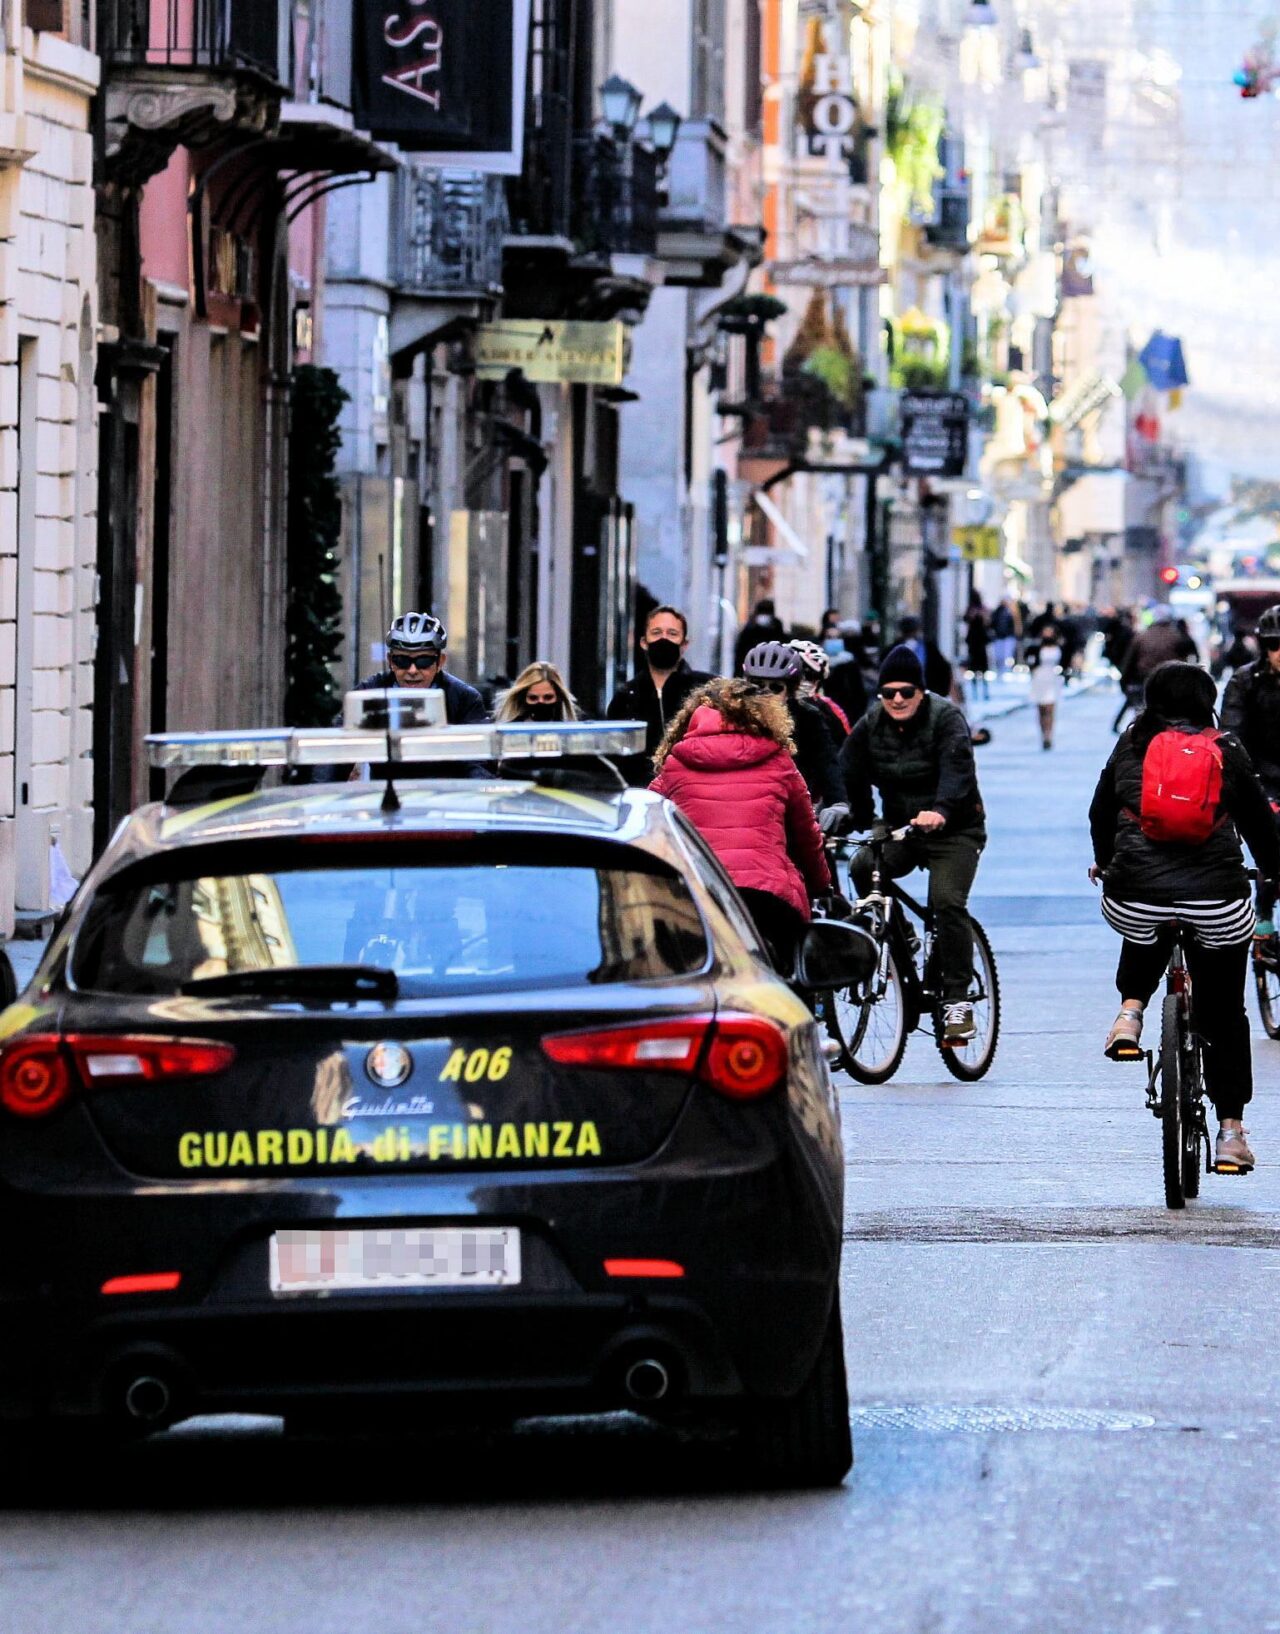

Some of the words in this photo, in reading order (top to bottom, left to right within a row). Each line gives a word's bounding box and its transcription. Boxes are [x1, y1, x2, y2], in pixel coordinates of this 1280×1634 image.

[382, 0, 444, 112] AS
[439, 1047, 512, 1083] A06
[178, 1128, 357, 1167] GUARDIA
[373, 1127, 410, 1163] di
[428, 1121, 601, 1161] FINANZA
